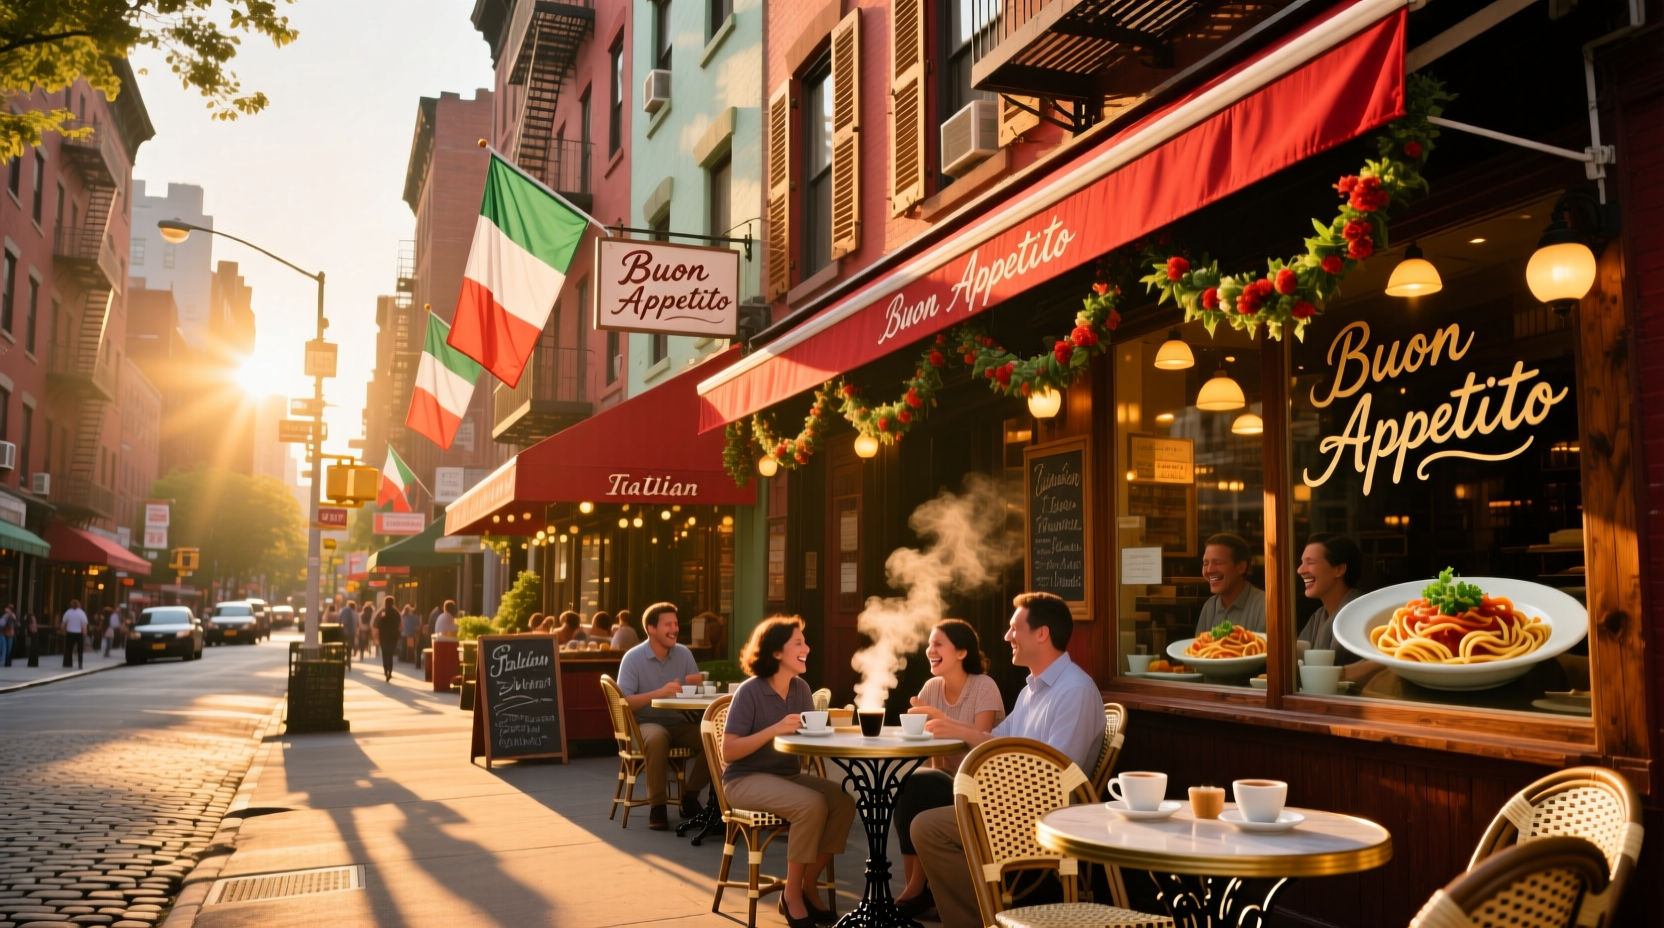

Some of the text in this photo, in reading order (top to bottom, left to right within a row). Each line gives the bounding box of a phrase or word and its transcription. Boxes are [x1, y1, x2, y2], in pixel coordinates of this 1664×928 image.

[611, 286, 732, 320] Appetito
[618, 250, 709, 285] Buon
[878, 215, 1076, 345] Buon Appetito
[1310, 321, 1474, 408] Buon
[1303, 361, 1568, 496] Appetito
